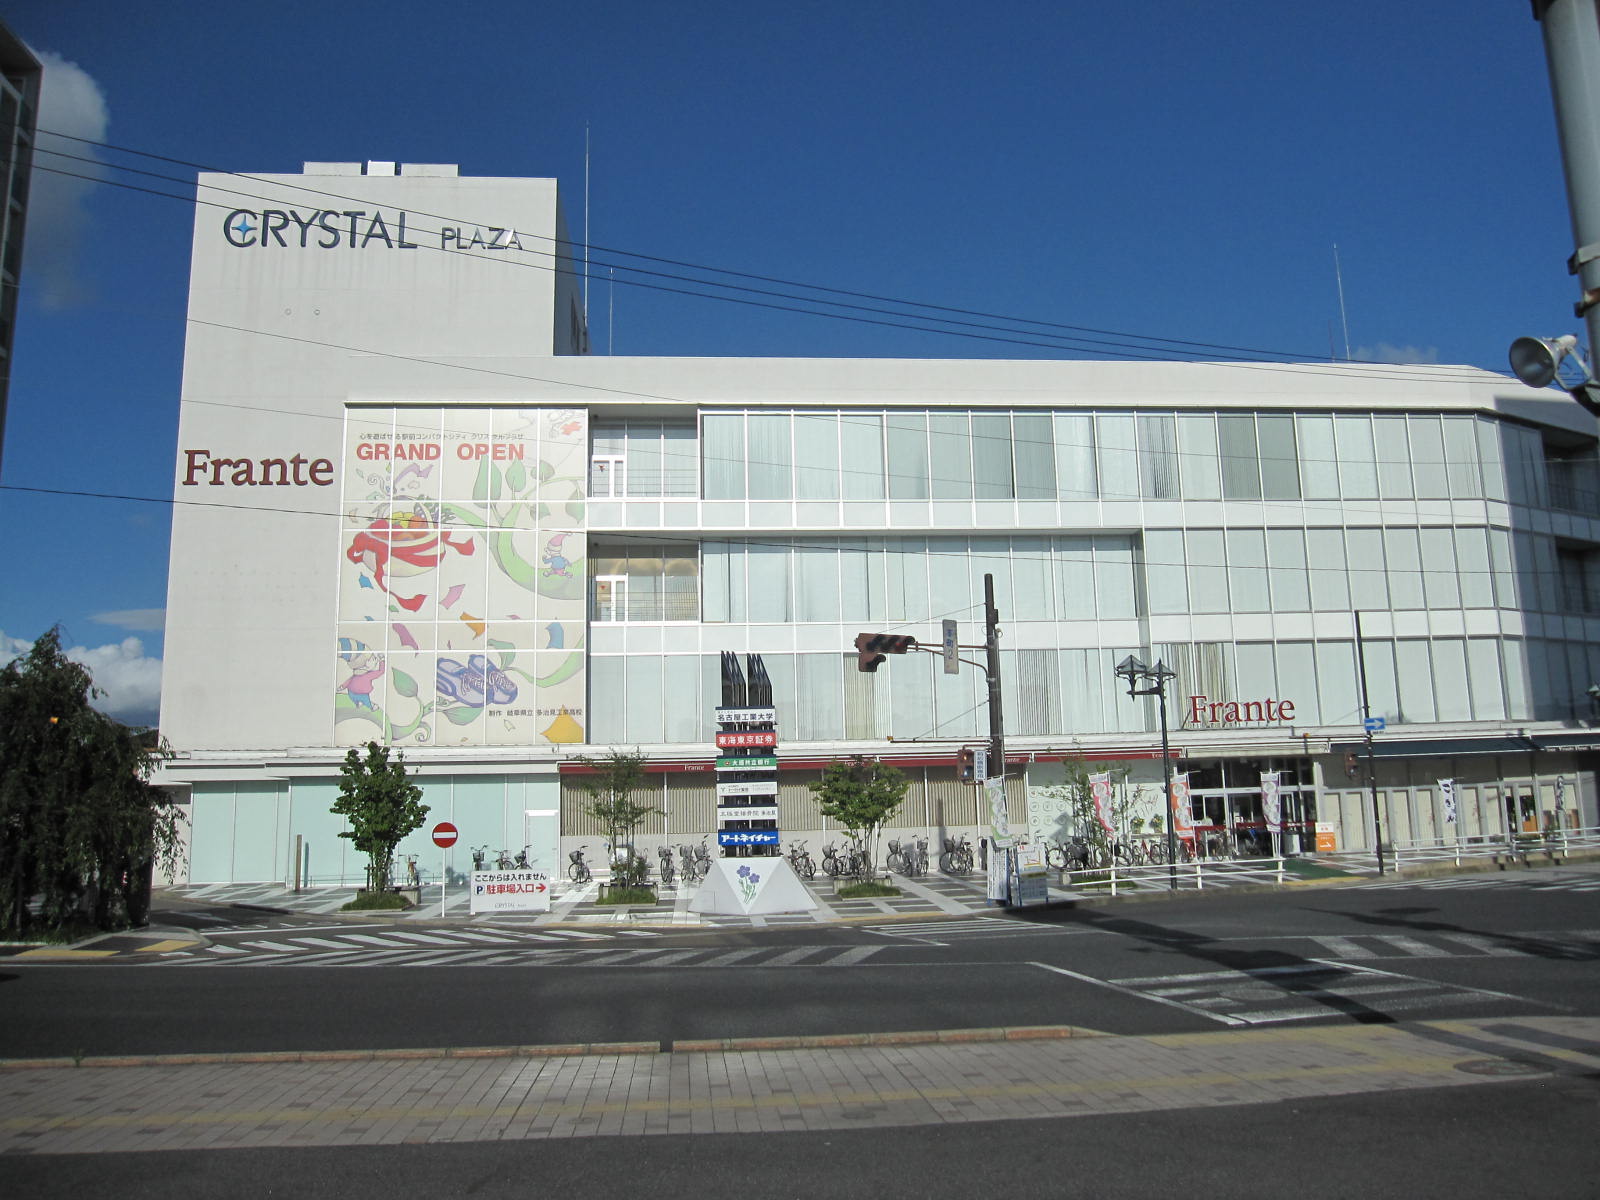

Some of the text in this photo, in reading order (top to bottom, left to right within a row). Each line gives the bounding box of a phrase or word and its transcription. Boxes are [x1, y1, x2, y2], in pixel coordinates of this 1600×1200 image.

[223, 209, 524, 251] CRYSTAL PLAZA
[356, 443, 525, 461] GRAND OPEN
[182, 449, 334, 487] Frante
[1190, 695, 1296, 724] Frante
[718, 713, 773, 721] 名古屋工業大学
[718, 735, 774, 745] 東海東京証券
[721, 834, 777, 843] アートネイチャー
[475, 873, 547, 882] ここからは入れません
[476, 886, 484, 895] P
[486, 883, 535, 895] 駐車場入口
